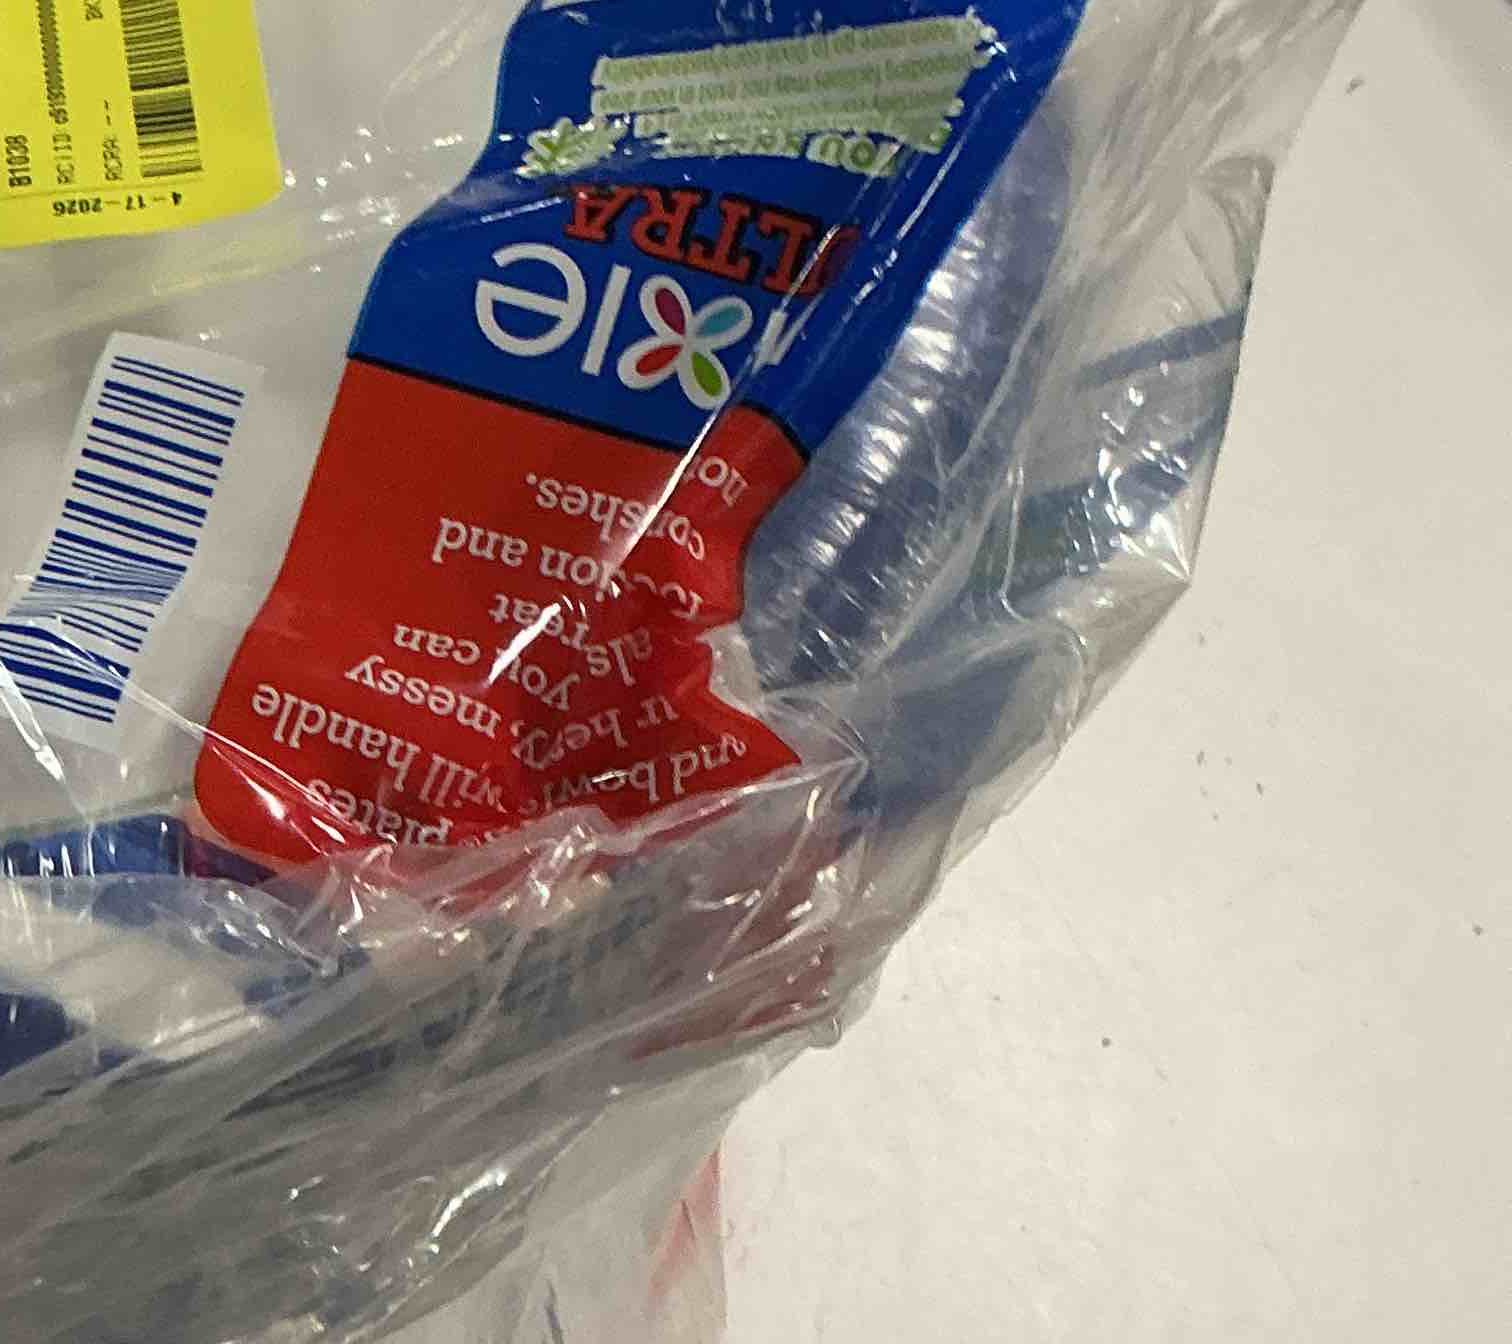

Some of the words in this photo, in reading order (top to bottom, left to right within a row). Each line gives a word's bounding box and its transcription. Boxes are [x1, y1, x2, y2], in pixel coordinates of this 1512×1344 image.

[431, 516, 529, 564] and
[392, 622, 481, 667] can
[344, 655, 502, 740] messy
[251, 682, 422, 794] handle
